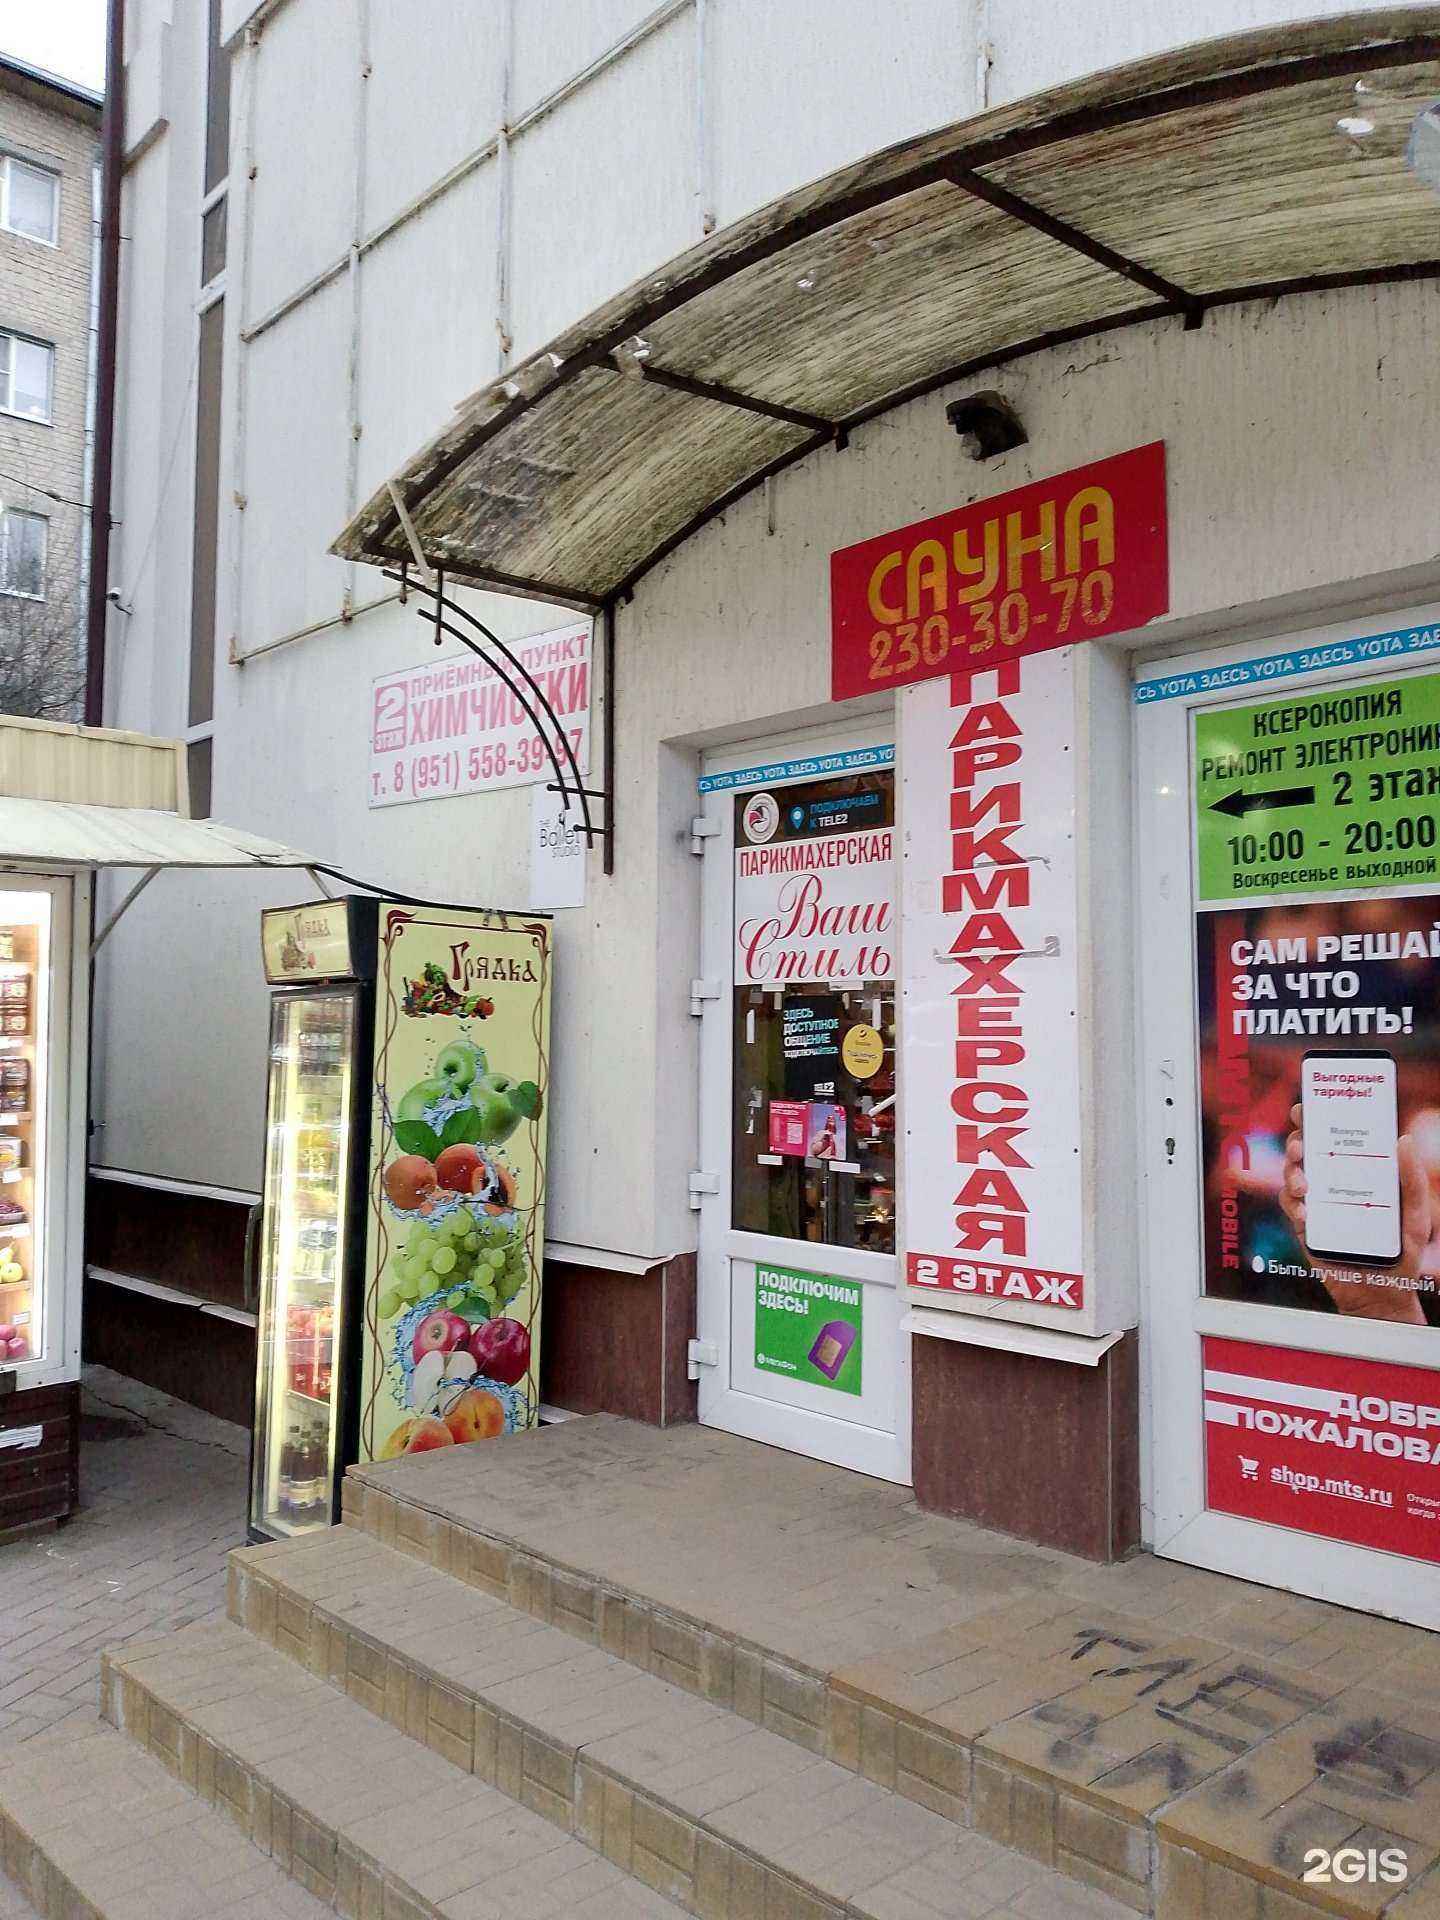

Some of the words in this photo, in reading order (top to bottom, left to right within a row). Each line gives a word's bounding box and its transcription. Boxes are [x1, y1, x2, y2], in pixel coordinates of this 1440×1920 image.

[868, 486, 1114, 626] САУНА
[868, 569, 1114, 680] 230-30-70
[521, 633, 588, 669] ПУНКТ
[1159, 678, 1197, 696] YOTA
[1200, 668, 1250, 688] ЗДЕСЬ
[1252, 658, 1295, 677] YOTA
[1300, 647, 1354, 668] ЗДЕСЬ
[1357, 637, 1404, 656] YOTA
[408, 661, 588, 745] ХИМЧИСТКИ
[1254, 689, 1402, 737] КСЕРОКОПИЯ
[394, 761, 404, 792] 8
[412, 750, 460, 798] (951)
[1202, 747, 1287, 781] РЕМОНТ
[1332, 771, 1353, 806] 2
[818, 813, 849, 828] TELE2
[1227, 829, 1304, 866] 10:00
[1345, 815, 1435, 855] 20:00
[740, 832, 892, 877] ПАРИКМАХЕРСКАЯ
[1233, 866, 1339, 891] Воскресенье
[1346, 856, 1436, 880] выходной
[775, 873, 893, 940] Ваш
[739, 918, 892, 980] Стиль
[942, 657, 1035, 1257] ПАРИКМАХЕРСКАЯ
[1231, 936, 1307, 967] САМ
[1231, 973, 1279, 1001] ЗА
[1285, 970, 1360, 1000] ЧТО
[1231, 1005, 1414, 1036] ПЛАТИТЬ!
[1312, 1071, 1386, 1086] Выгодные
[1313, 1085, 1374, 1099] тарифы!
[759, 1270, 859, 1306] ПОДКЛЮЧИМ
[916, 1259, 939, 1285] 2
[952, 1264, 1077, 1306] ЭТАЖ
[1268, 1261, 1307, 1277] Быть
[1310, 1266, 1362, 1284] лучше
[1366, 1273, 1435, 1293] каждый
[1270, 1464, 1393, 1506] shop.mts.ru
